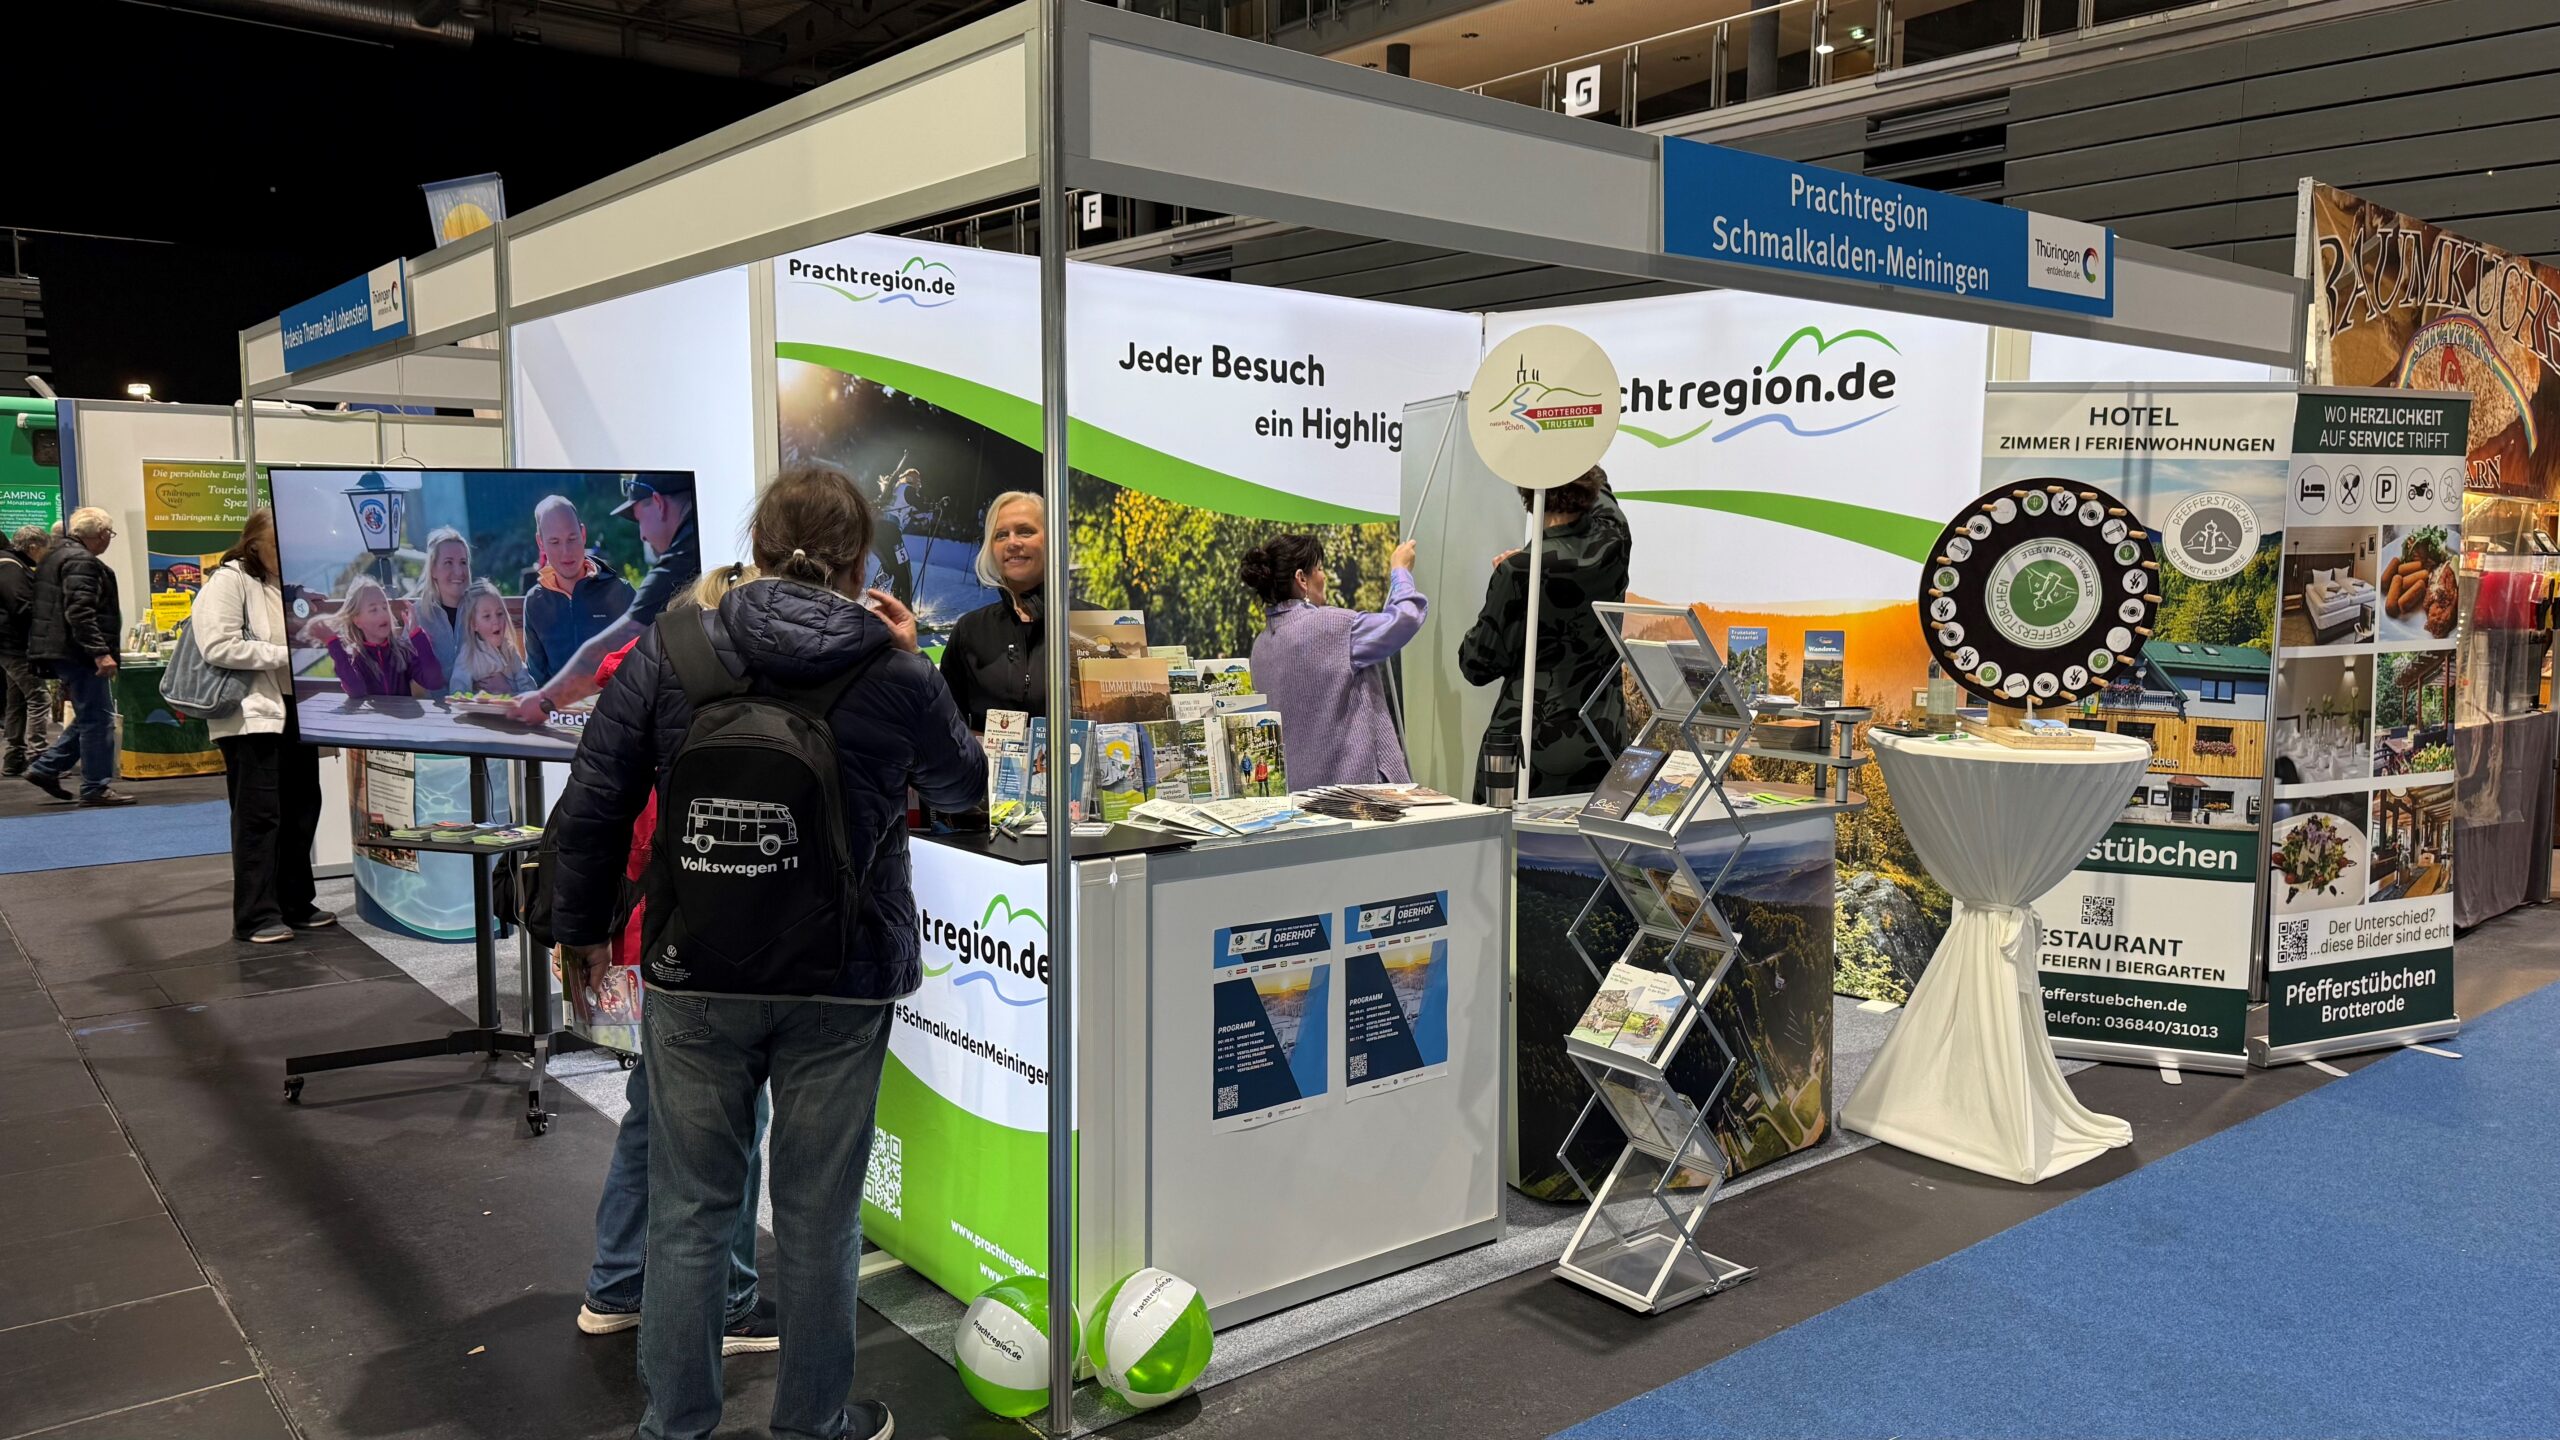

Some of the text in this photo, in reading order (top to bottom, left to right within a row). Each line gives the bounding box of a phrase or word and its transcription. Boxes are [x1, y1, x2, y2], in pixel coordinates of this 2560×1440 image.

[1575, 76, 1592, 107] G
[1088, 200, 1097, 224] F
[1791, 173, 1928, 233] Prachtregion
[1712, 215, 1989, 295] Schmalkalden-Meiningen
[2035, 238, 2081, 268] Thüringen
[789, 258, 956, 296] Prachtregion.de
[284, 299, 369, 350] Ardesia Therme Bad Lobenstein
[1119, 342, 1325, 386] Jeder Besuch
[1255, 409, 1293, 438] ein
[1536, 406, 1597, 417] BROTTERODE-
[1546, 419, 1588, 428] TRUSETAL
[2089, 407, 2179, 427] HOTEL
[2324, 405, 2443, 427] WO HERZLICHKEIT
[2000, 436, 2070, 450] ZIMMER
[2085, 437, 2275, 452] FERIENWOHNUNGEN
[2319, 429, 2449, 449] AUF SERVICE TRIFFT
[152, 469, 168, 477] Die
[170, 470, 220, 479] persönliche
[171, 513, 214, 522] Thüringen
[1076, 648, 1090, 656] Ihre
[2086, 837, 2238, 871] stübchen
[680, 856, 799, 878] Volkswagen T1
[1397, 905, 1434, 920] OBERHOF
[2329, 908, 2436, 935] Der Unterschied?
[1273, 928, 1316, 943] OBERHOF
[2357, 932, 2394, 949] Bilder
[2395, 926, 2421, 943] sind
[2424, 924, 2450, 940] echt
[2042, 953, 2101, 971] FEIERN
[2116, 960, 2226, 982] BIERGARTEN
[1350, 992, 1384, 1006] PROGRAMM
[2285, 967, 2436, 1007] Pfefferstübchen
[2321, 996, 2405, 1023] Brotterode
[1217, 1020, 1256, 1034] PROGRAMM
[2104, 1015, 2219, 1038] 036840/31013
[1132, 1277, 1173, 1318] Prachtregion.de
[973, 1319, 1023, 1361] Prachtregion.de
